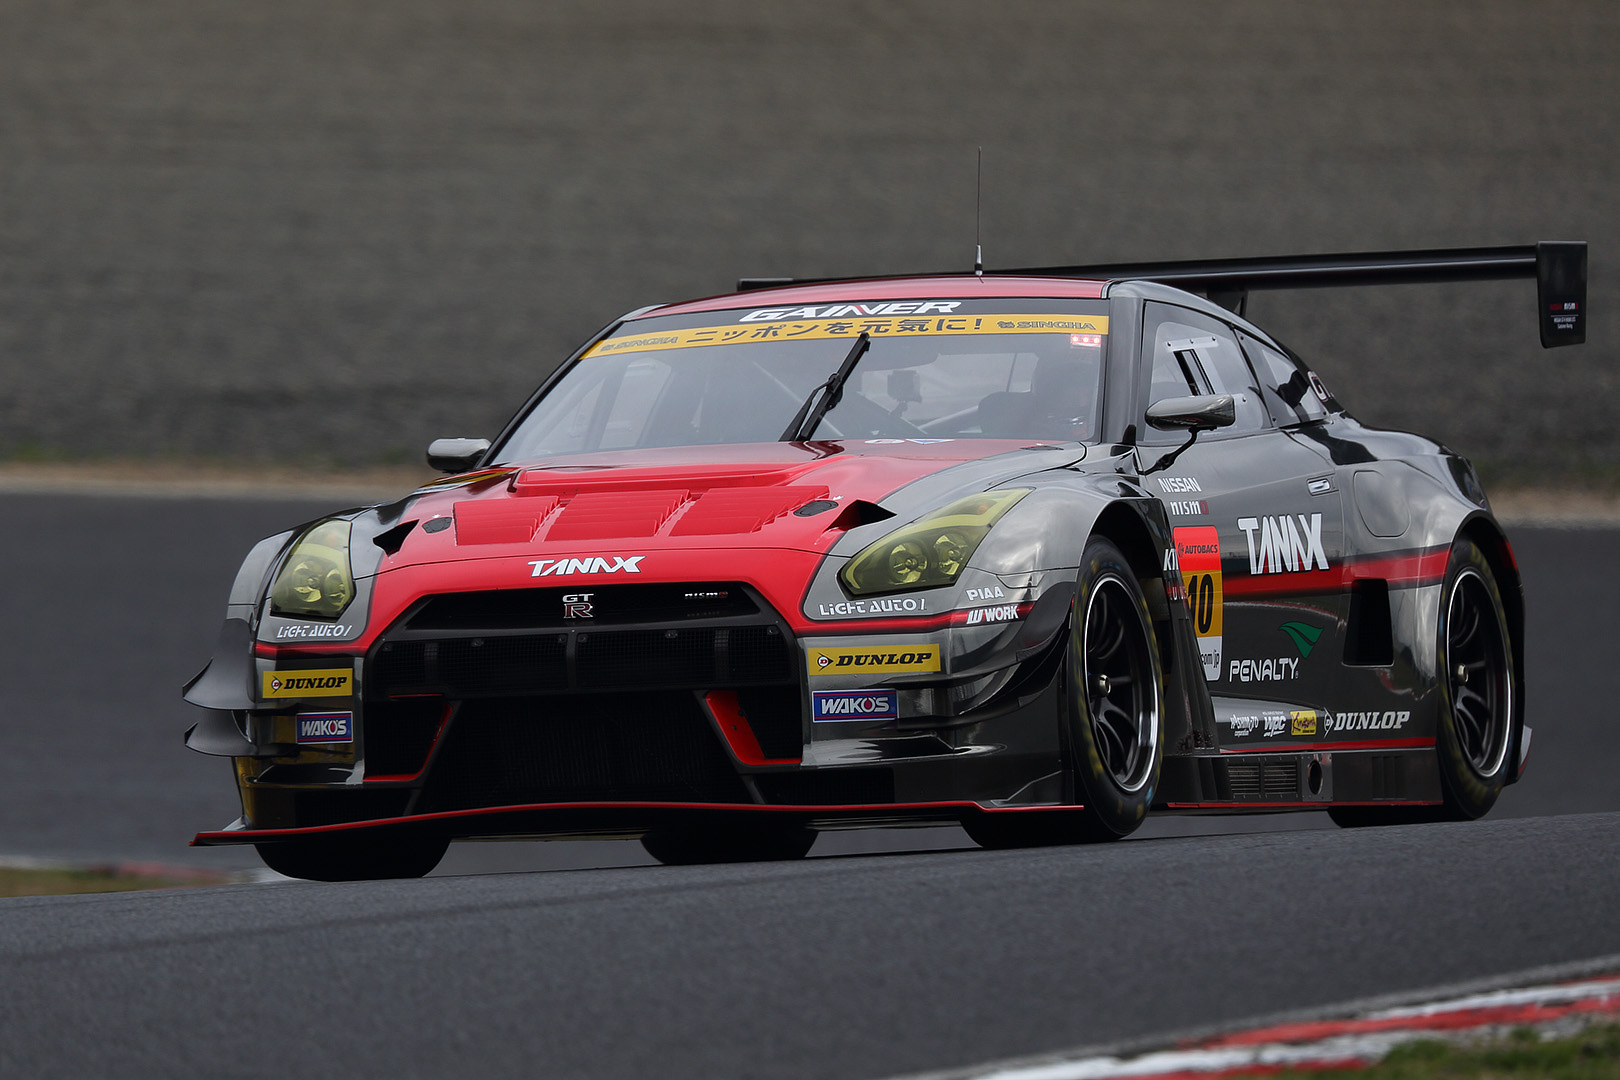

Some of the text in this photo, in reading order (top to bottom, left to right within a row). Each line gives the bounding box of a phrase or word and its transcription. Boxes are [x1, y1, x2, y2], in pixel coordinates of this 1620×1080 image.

[739, 301, 962, 322] GAINER
[1017, 321, 1097, 331] SINGHA
[1157, 477, 1202, 493] NISSAN
[1184, 544, 1218, 554] AUTOBACS
[1237, 513, 1330, 575] TANAX
[527, 556, 647, 577] TANAX
[562, 593, 594, 603] GT
[965, 586, 1005, 601] PIAA
[563, 603, 594, 619] R
[1187, 573, 1214, 634] 10
[985, 604, 1019, 622] WORK
[835, 652, 932, 667] DUNLOP
[1229, 657, 1299, 683] PENALTY
[283, 676, 347, 690] DUNLOP
[1333, 711, 1411, 731] DUNLOP
